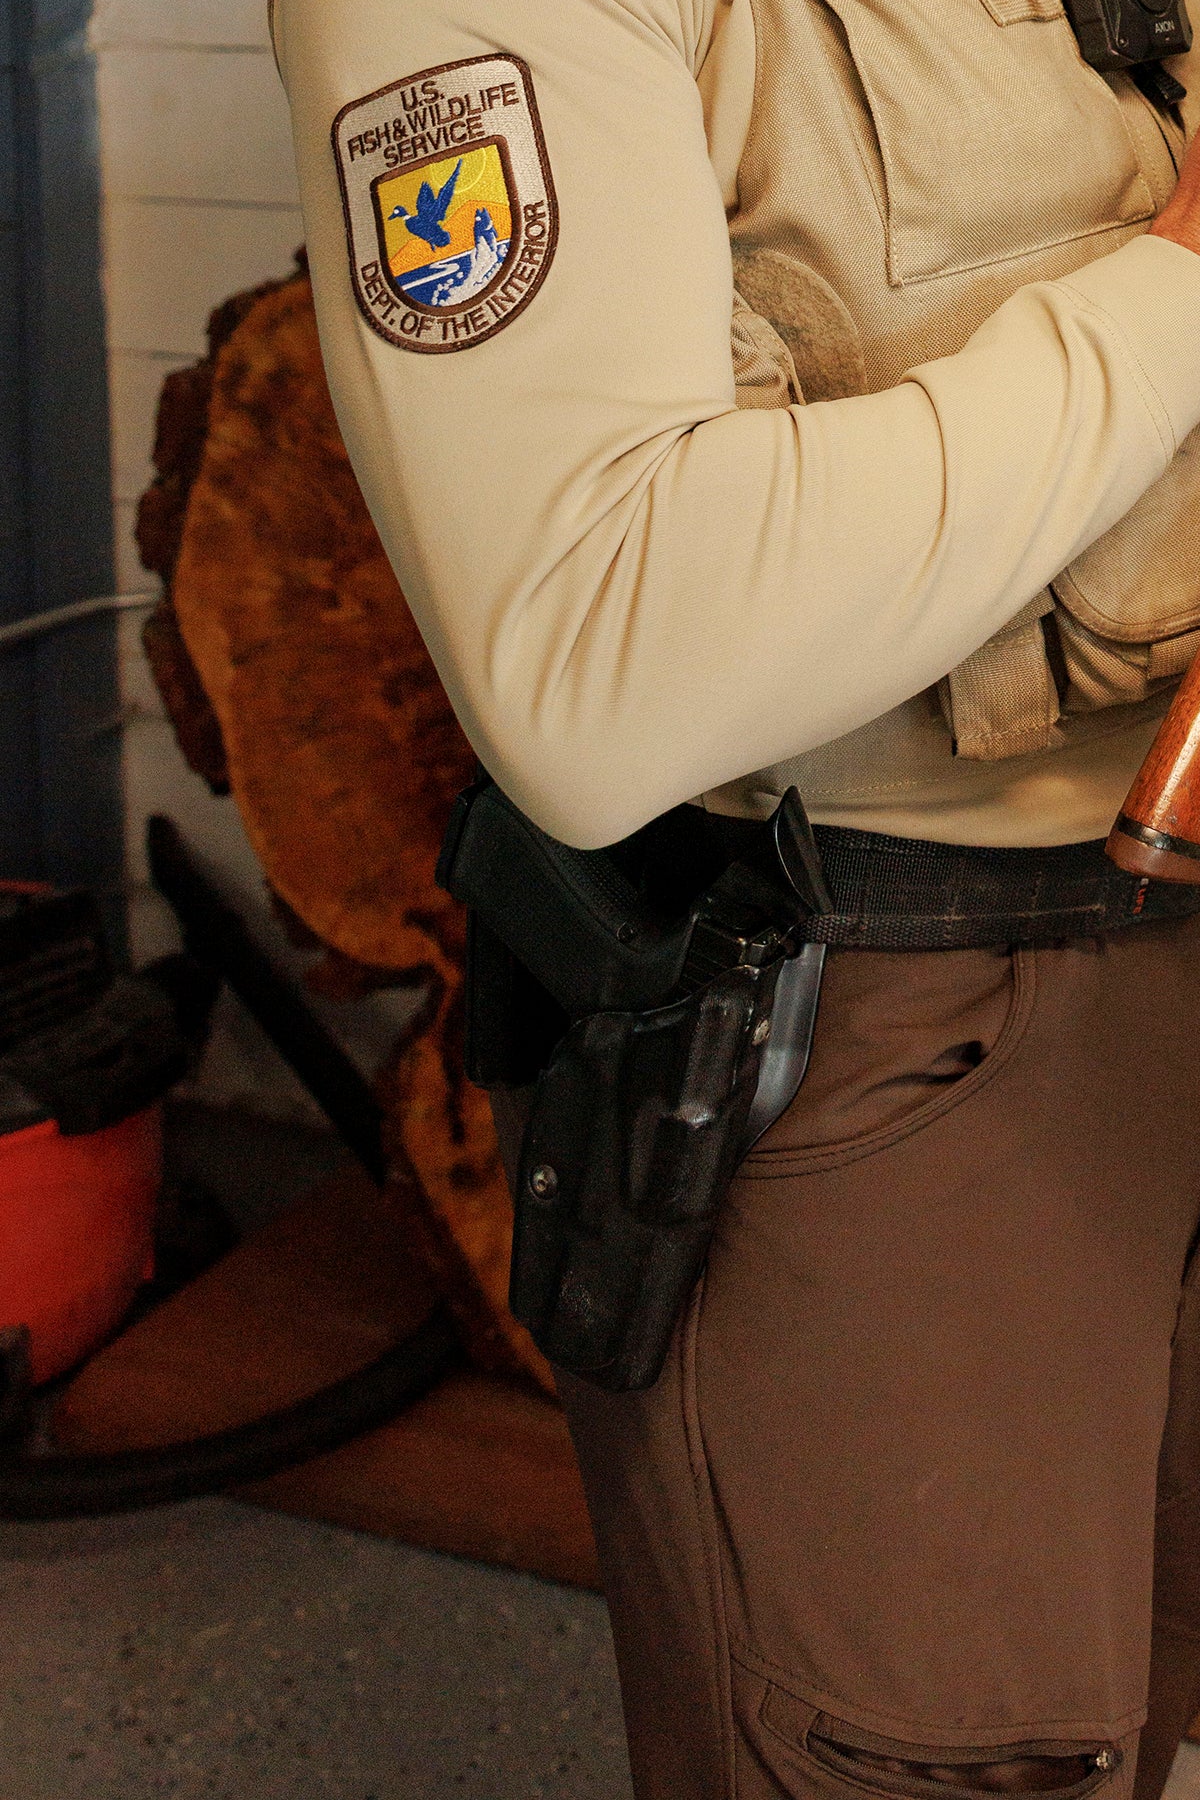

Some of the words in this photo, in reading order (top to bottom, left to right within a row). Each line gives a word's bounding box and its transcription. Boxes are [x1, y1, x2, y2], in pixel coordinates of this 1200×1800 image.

[1154, 20, 1176, 34] AXON
[400, 80, 445, 112] U.S.
[383, 114, 486, 169] SERVICE
[360, 260, 400, 326] DEPT.
[400, 310, 435, 338] OF
[435, 304, 490, 341] THE
[485, 200, 548, 321] INTERIOR
